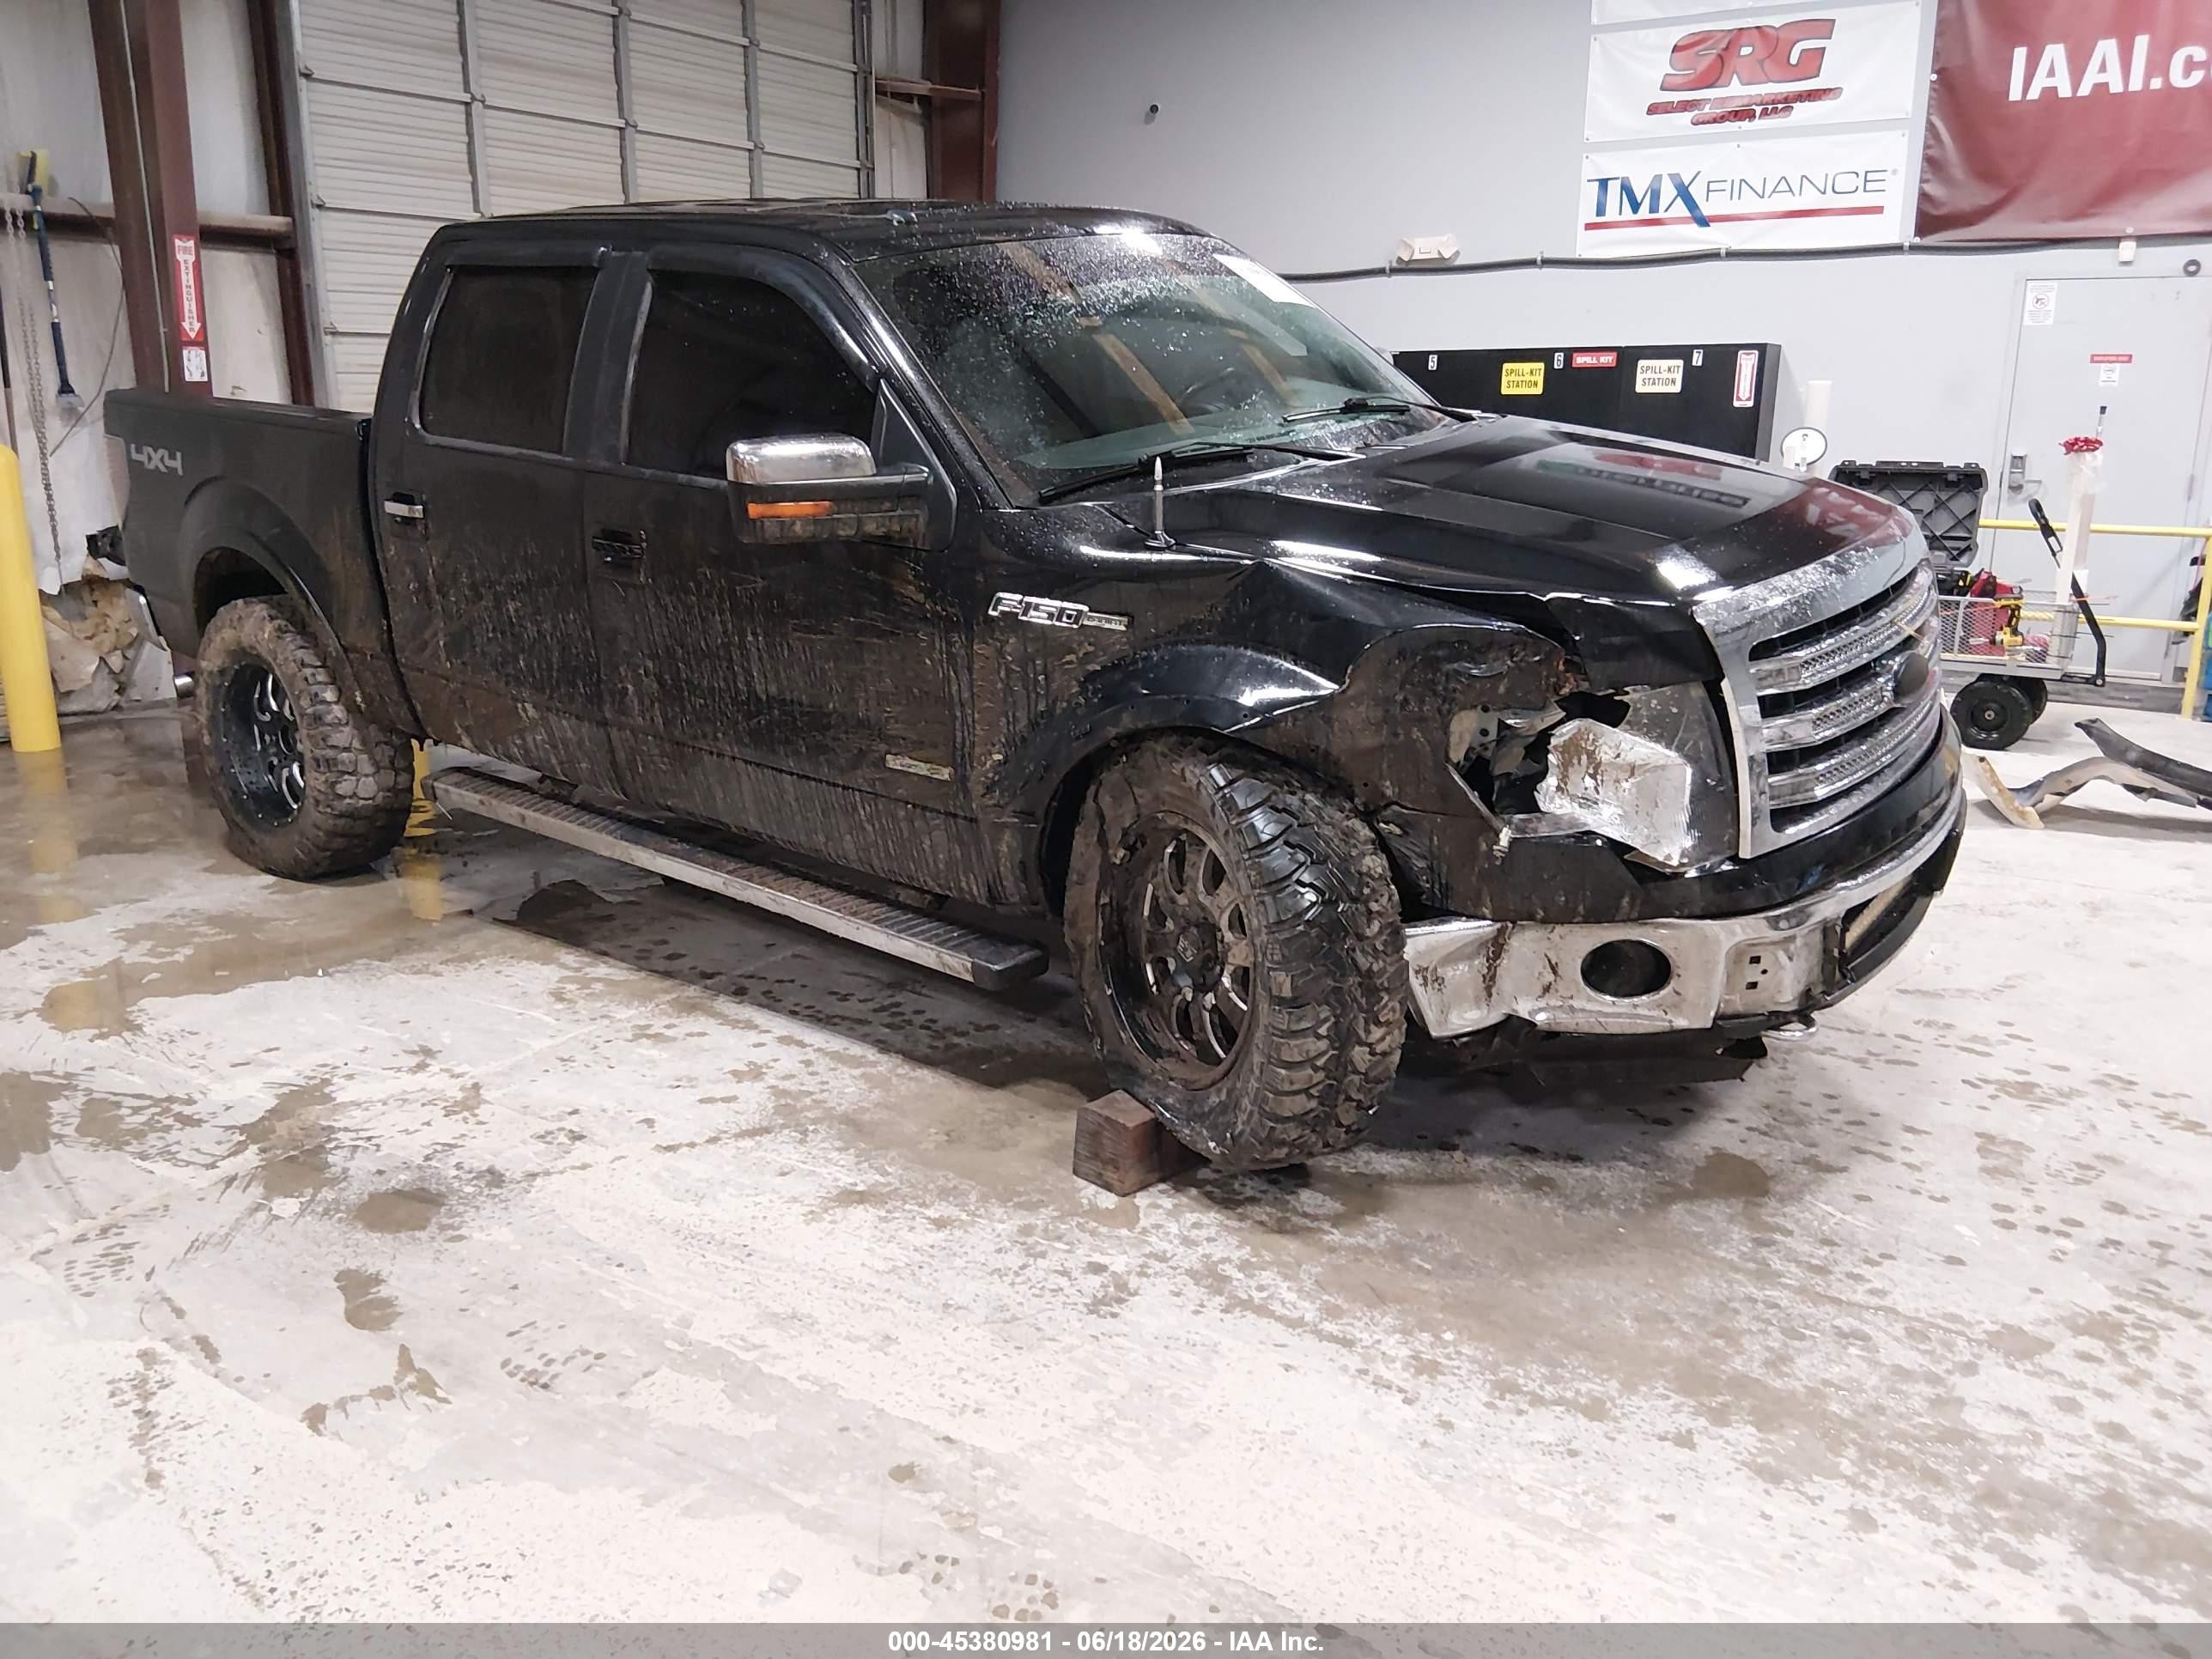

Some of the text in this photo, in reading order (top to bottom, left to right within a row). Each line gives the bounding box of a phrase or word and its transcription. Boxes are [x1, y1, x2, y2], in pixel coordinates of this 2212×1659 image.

[1660, 19, 1836, 91] SRG
[2008, 33, 2212, 101] IAAI.c
[177, 245, 194, 256] FIRE
[1599, 356, 1613, 364] KIT
[1504, 368, 1542, 377] SPILL-KIT
[1639, 365, 1681, 374] SPILL-KIT
[1506, 380, 1539, 389] STATION
[1641, 377, 1677, 386] STATION
